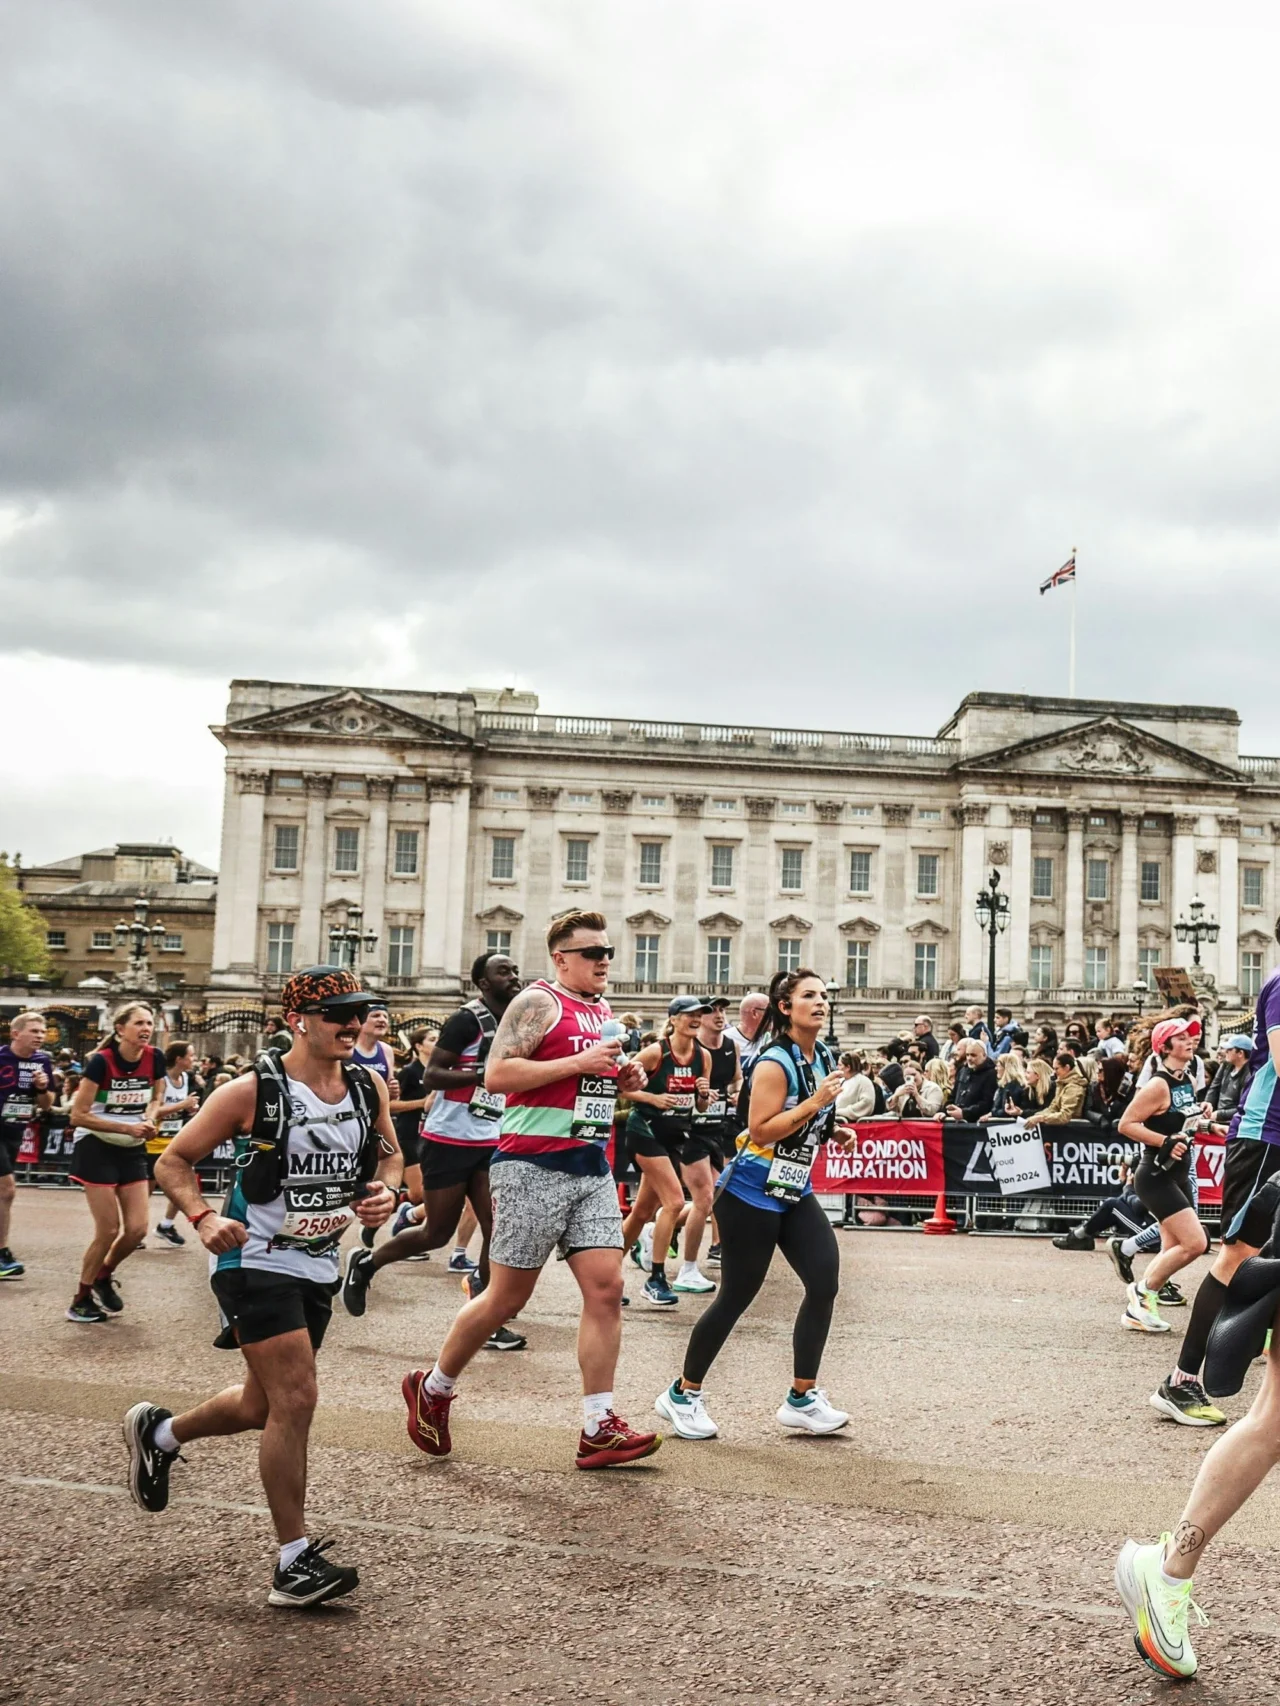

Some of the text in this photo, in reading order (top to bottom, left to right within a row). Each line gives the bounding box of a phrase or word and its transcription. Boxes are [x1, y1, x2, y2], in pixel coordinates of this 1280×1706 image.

[111, 1079, 128, 1089] tcs
[581, 1078, 602, 1095] tcs
[826, 1159, 928, 1179] MARATHON
[1017, 1171, 1040, 1183] 2024
[290, 1190, 324, 1208] tcs
